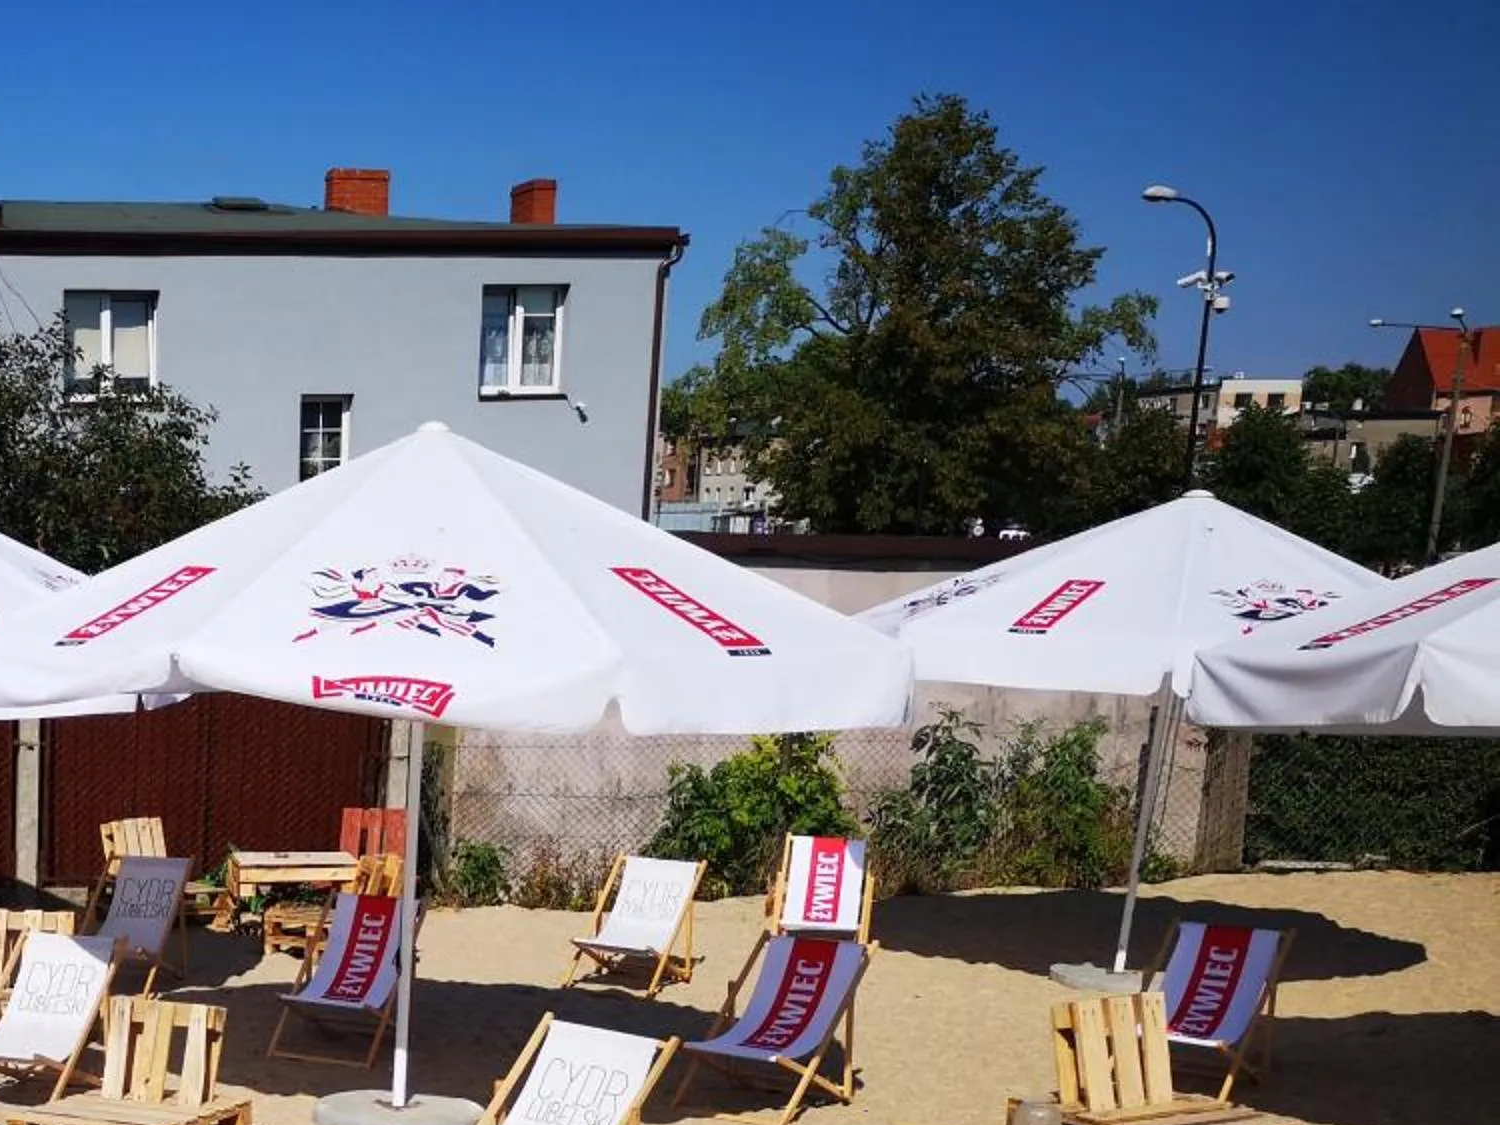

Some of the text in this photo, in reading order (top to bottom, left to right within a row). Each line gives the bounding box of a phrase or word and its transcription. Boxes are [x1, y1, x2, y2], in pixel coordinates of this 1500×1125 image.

[120, 877, 176, 904] CYDR
[807, 852, 838, 919] ŻYWIEC
[26, 962, 97, 998] CYDR
[333, 913, 385, 995] ŻYWIEC
[754, 960, 823, 1045] ŻYWIEC
[1173, 946, 1238, 1033] ŻYWIEC
[538, 1057, 629, 1112] CYDR
